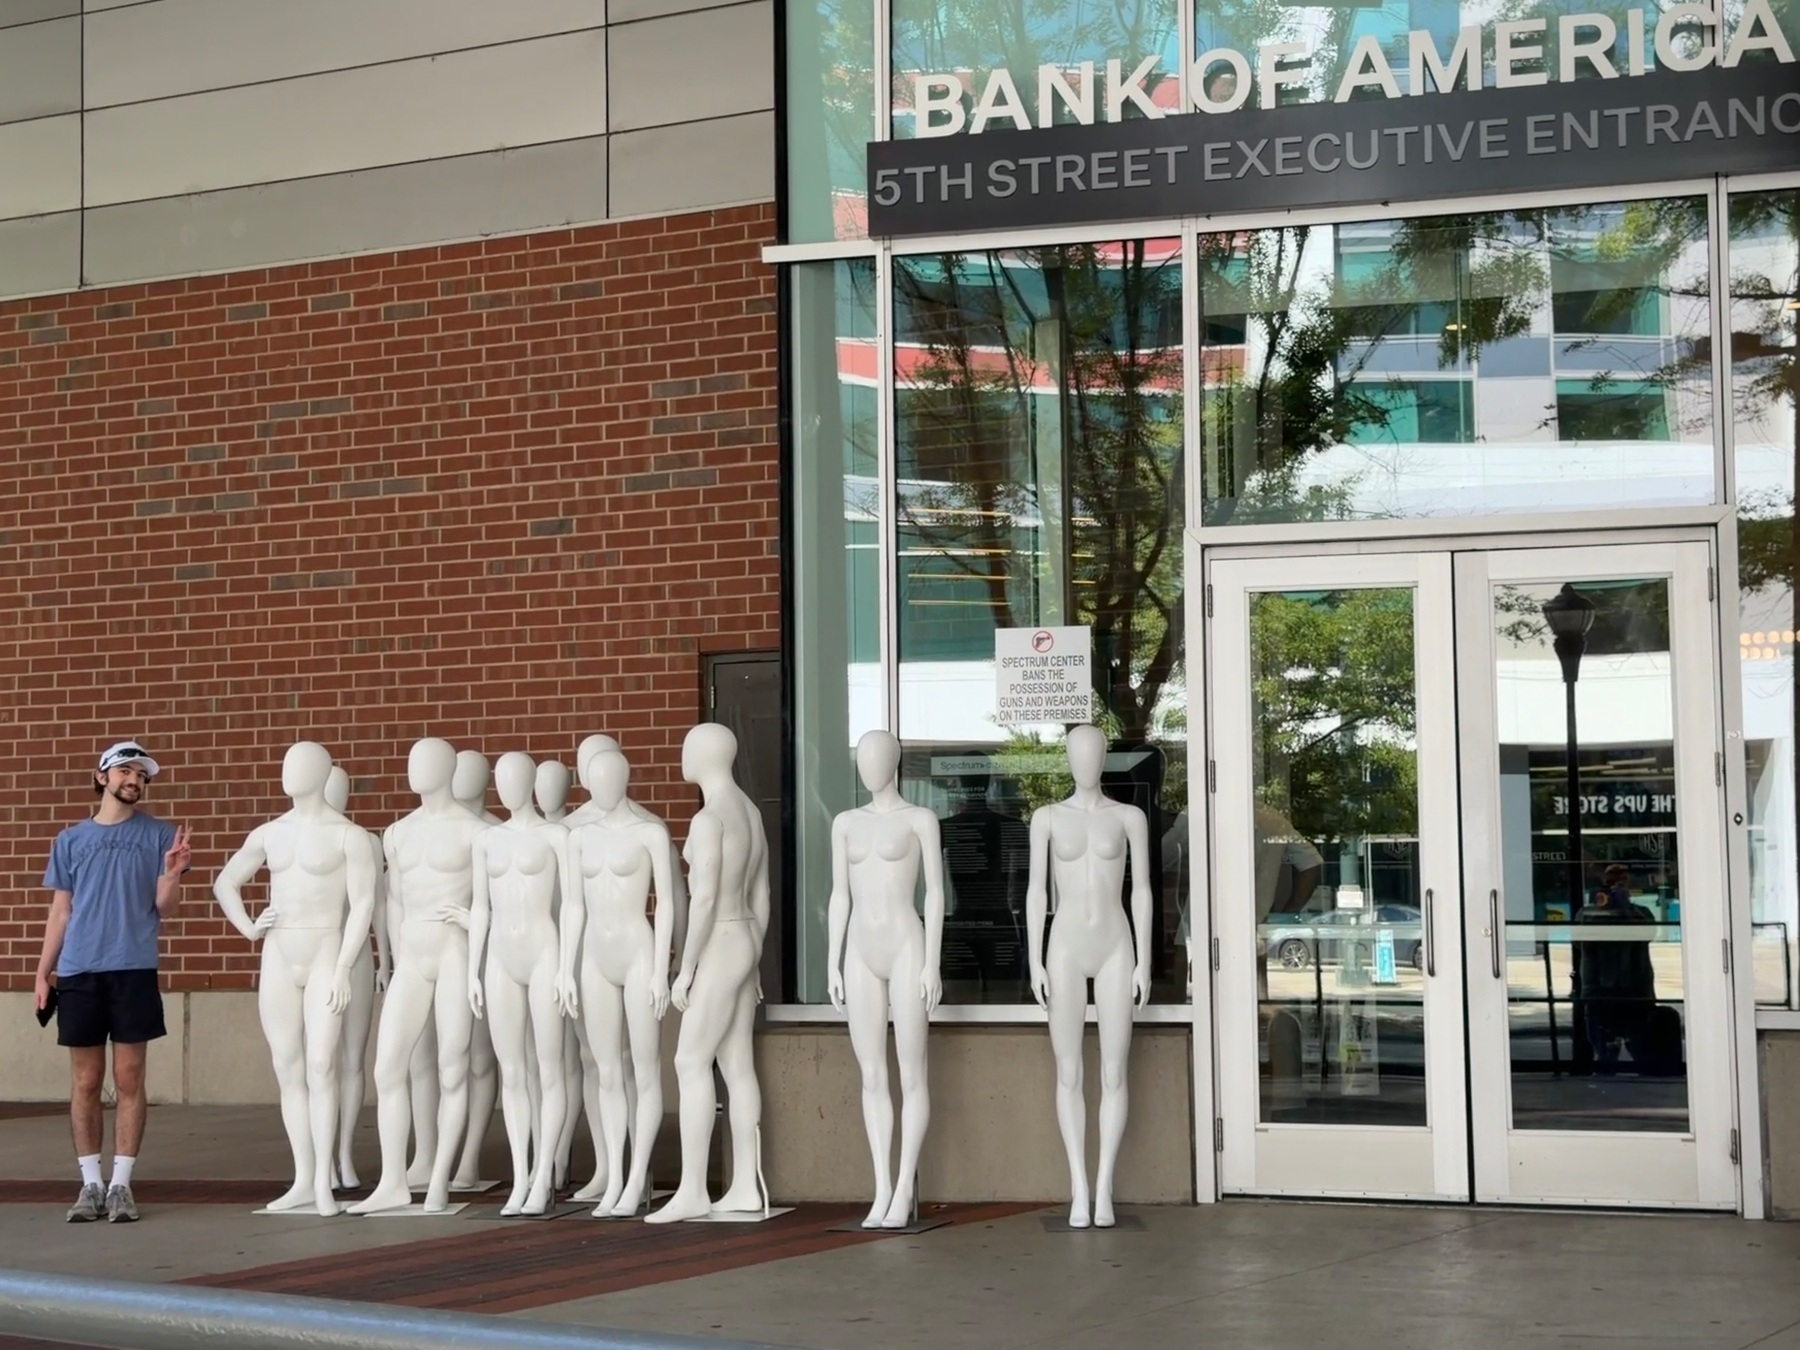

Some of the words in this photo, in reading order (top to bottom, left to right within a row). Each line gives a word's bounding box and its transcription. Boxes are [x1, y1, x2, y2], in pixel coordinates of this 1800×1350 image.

[915, 55, 1166, 139] BANK
[1189, 42, 1306, 115] OF
[1334, 0, 1796, 104] AMERICA
[874, 162, 973, 206] 5TH
[986, 145, 1188, 198] STREET
[1204, 118, 1509, 182] EXECUTIVE
[1002, 656, 1049, 668] SPECTRUM
[1050, 655, 1085, 667] CENTER
[1022, 670, 1046, 680] BANS
[1048, 669, 1065, 680] THE
[1010, 683, 1064, 694] POSSESSION
[1066, 682, 1078, 692] OF
[1000, 697, 1024, 708] GUNS
[1025, 696, 1043, 707] AND
[1045, 695, 1089, 706] WEAPONS
[1000, 711, 1012, 721] ON
[1014, 710, 1042, 721] THESE
[1044, 709, 1089, 720] PREMISES.
[941, 761, 981, 771] Spectrum
